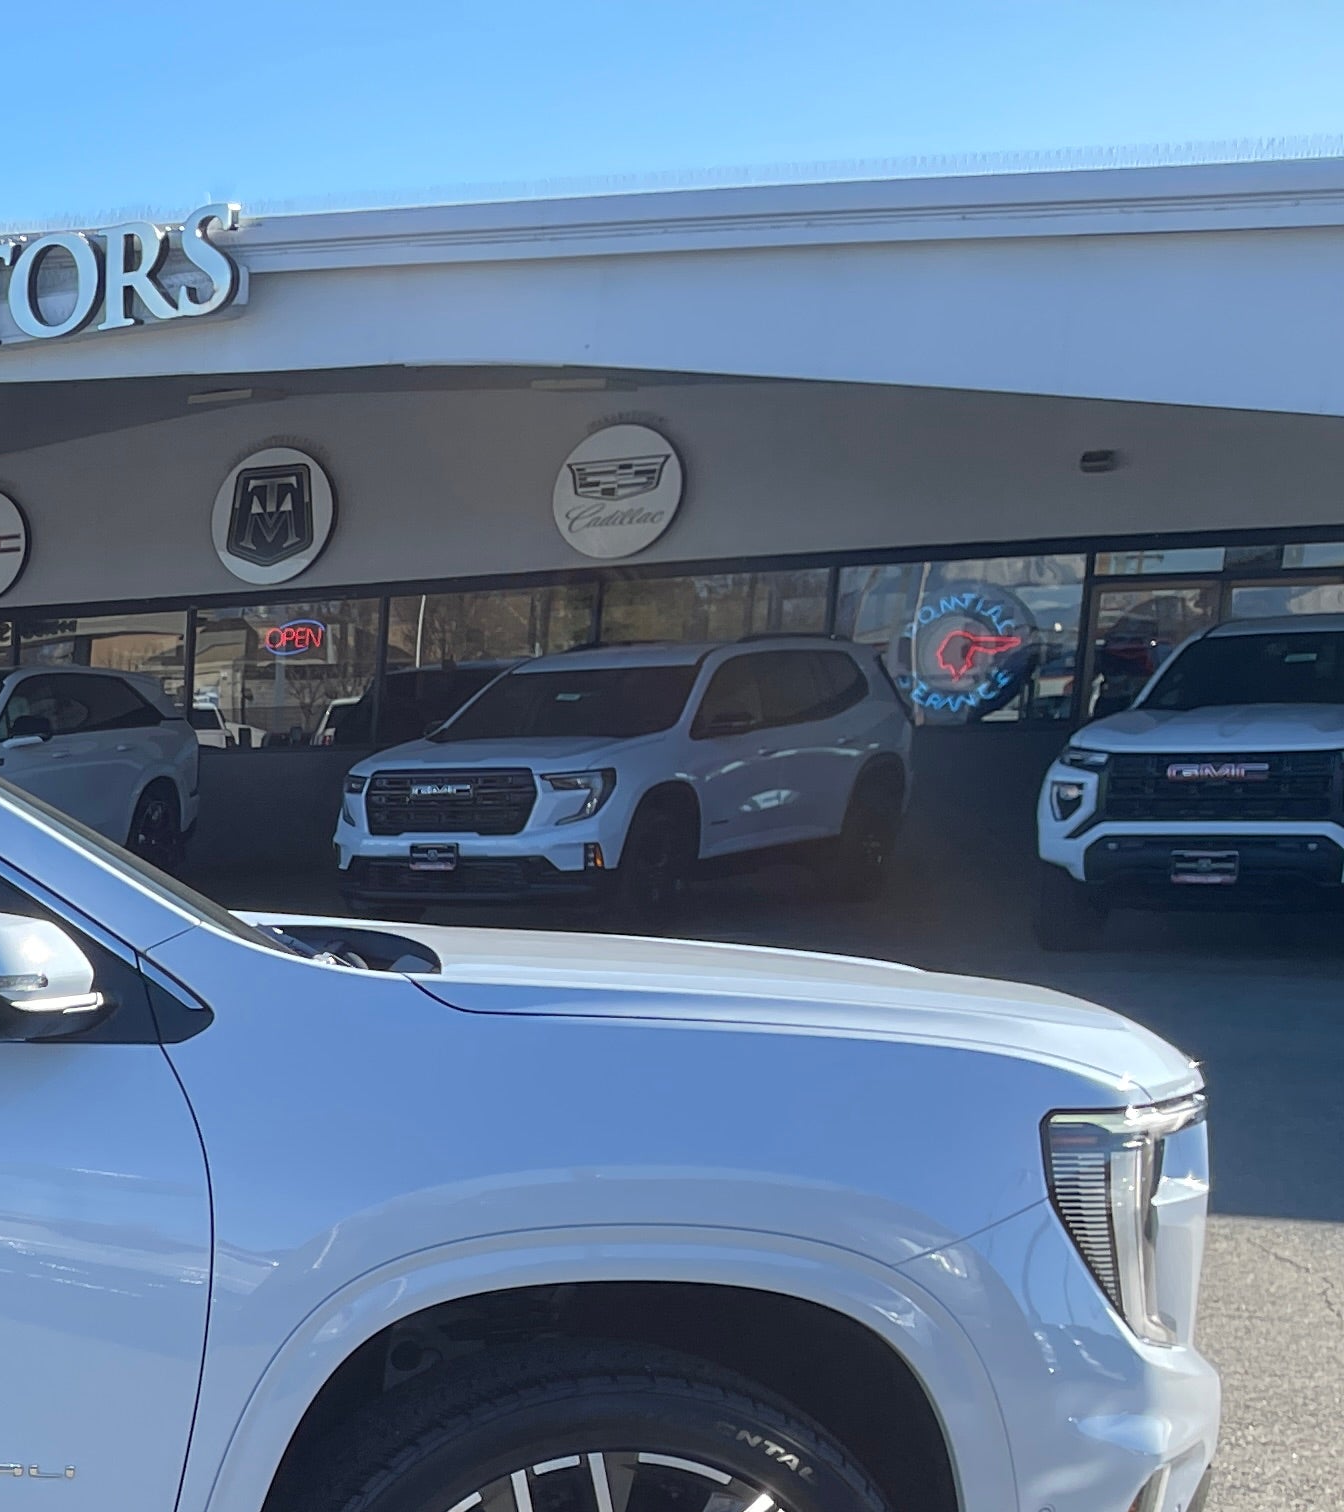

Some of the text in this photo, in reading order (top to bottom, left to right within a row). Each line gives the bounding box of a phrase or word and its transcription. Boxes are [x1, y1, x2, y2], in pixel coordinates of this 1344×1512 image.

[565, 502, 665, 533] Cadillac
[265, 627, 322, 649] OPEN
[1167, 762, 1269, 782] GMC
